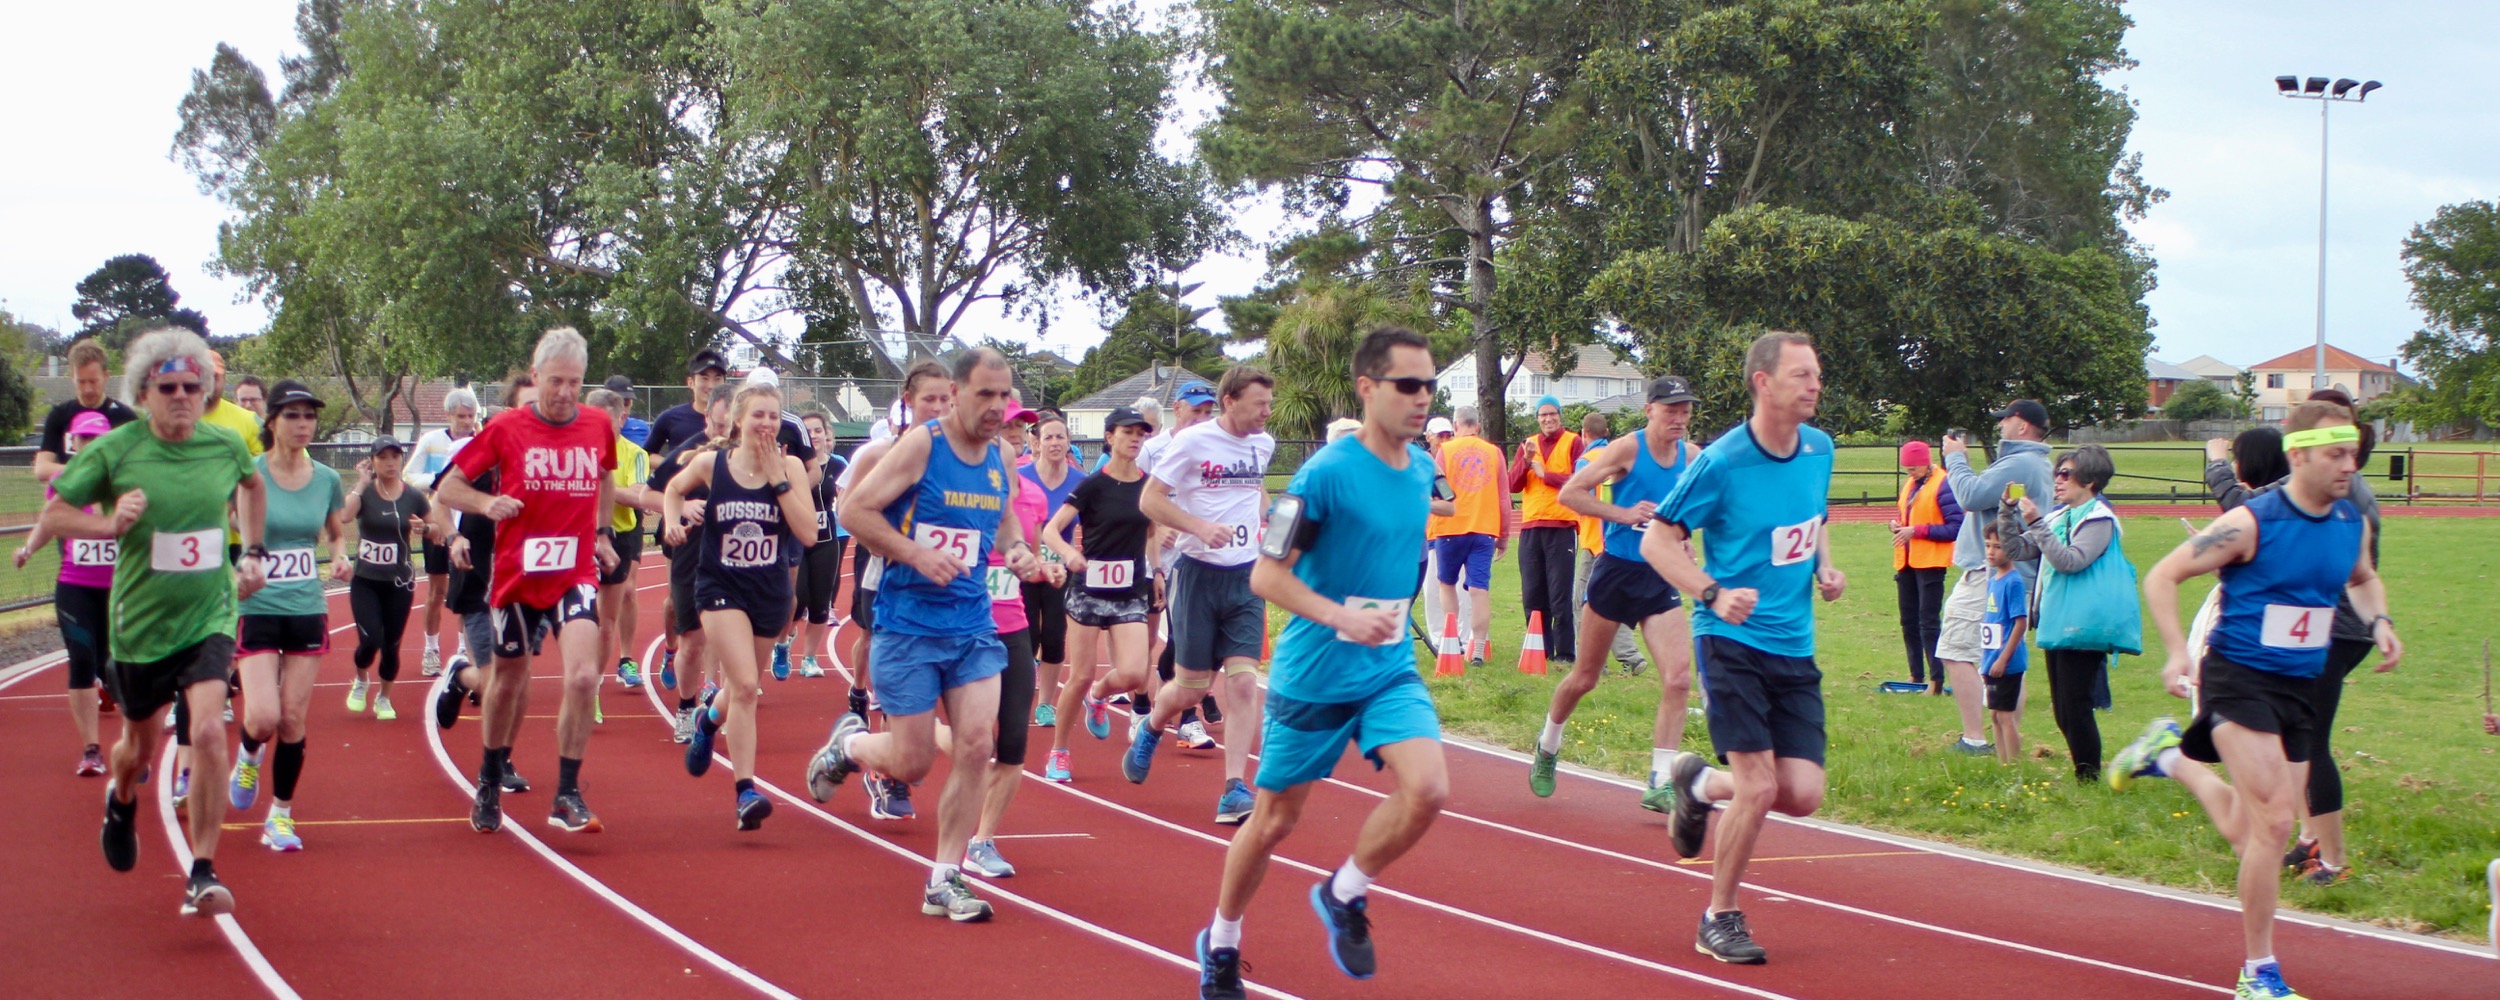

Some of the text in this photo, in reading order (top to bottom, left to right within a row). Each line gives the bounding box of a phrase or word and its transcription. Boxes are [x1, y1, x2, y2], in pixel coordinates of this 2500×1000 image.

[525, 446, 598, 479] RUN
[523, 480, 597, 492] TO THE HILLS
[716, 501, 779, 523] RUSSELL
[943, 490, 1001, 511] TAKAPUNA
[817, 512, 825, 527] 4
[79, 542, 116, 562] 215
[180, 536, 200, 567] 3
[363, 543, 393, 563] 210
[535, 540, 569, 567] 27
[727, 538, 773, 562] 200
[929, 529, 969, 561] 25
[267, 552, 311, 579] 220
[1098, 563, 1126, 585] 10
[986, 568, 1014, 596] 47
[1982, 626, 1992, 646] 9
[2289, 611, 2311, 643] 4
